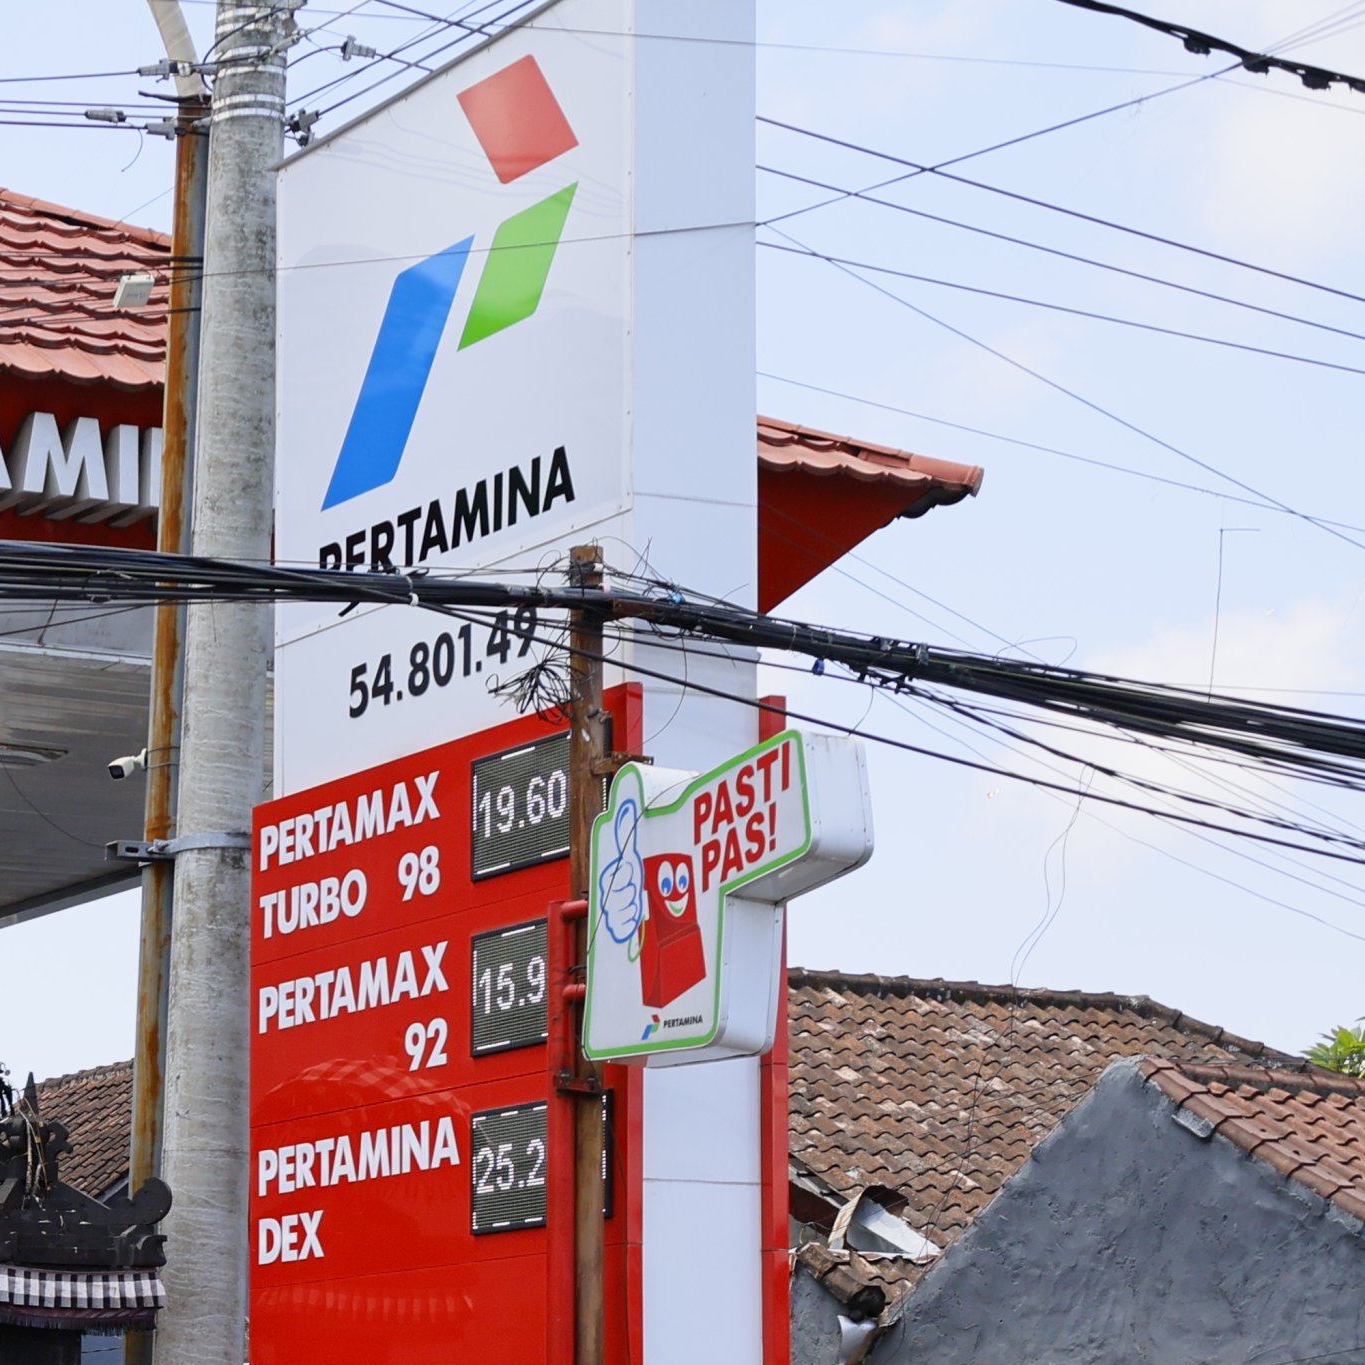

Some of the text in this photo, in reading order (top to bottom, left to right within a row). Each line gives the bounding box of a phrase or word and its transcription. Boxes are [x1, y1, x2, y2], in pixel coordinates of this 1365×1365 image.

[259, 771, 442, 871] PERTAMAX
[478, 769, 568, 839] 19.60
[694, 741, 790, 845] PASTI
[702, 800, 777, 891] PAS!
[259, 846, 441, 939] TURBO 98
[258, 941, 449, 1034] PERTAMAX
[479, 956, 546, 1015] 15.9
[663, 1013, 703, 1031] PERTAMINA
[405, 1018, 448, 1071] 92
[258, 1116, 460, 1197] PERTAMINA
[475, 1137, 545, 1195] 25.2
[258, 1210, 325, 1266] DEX
